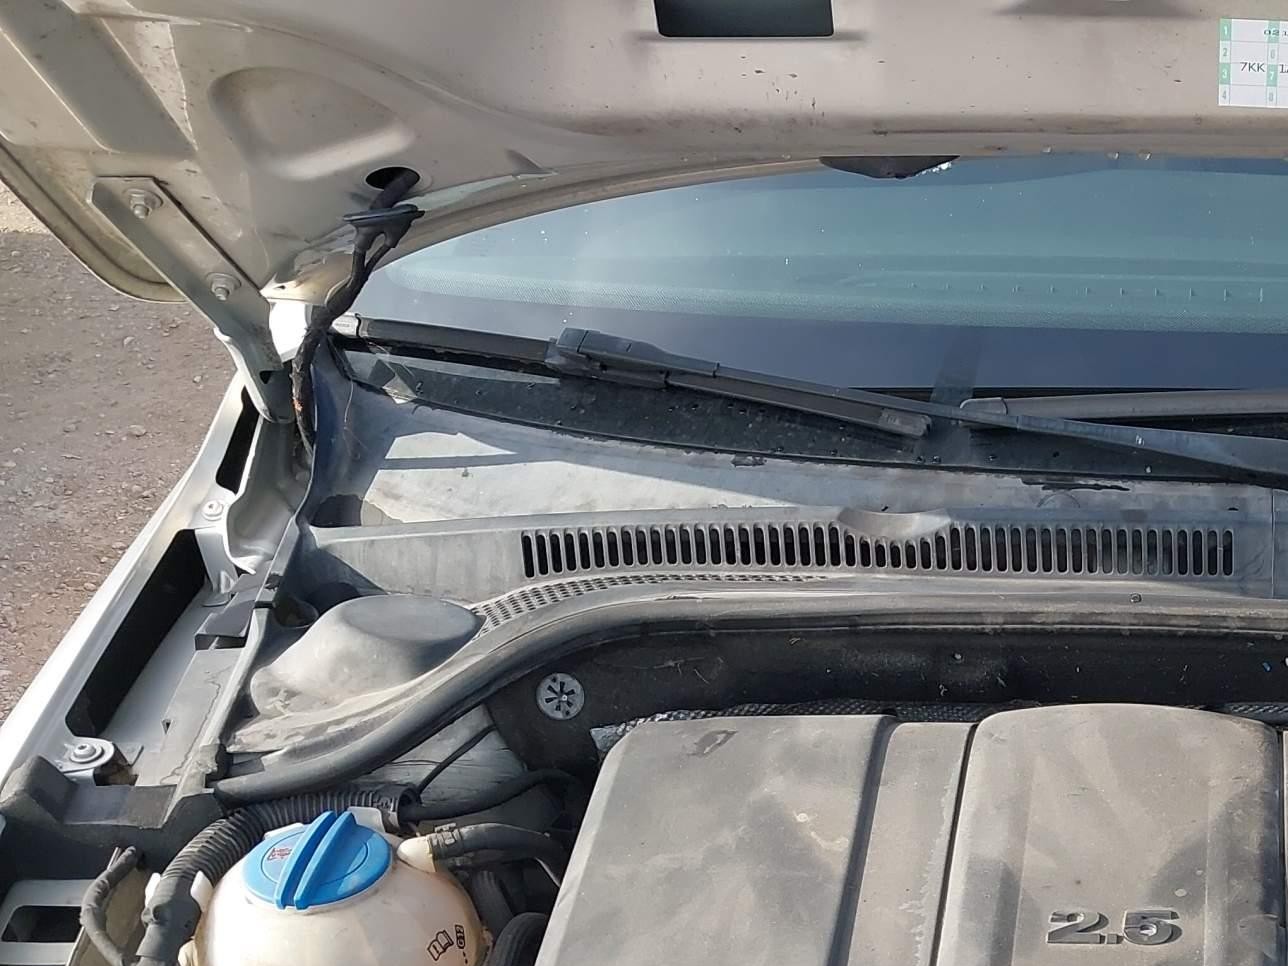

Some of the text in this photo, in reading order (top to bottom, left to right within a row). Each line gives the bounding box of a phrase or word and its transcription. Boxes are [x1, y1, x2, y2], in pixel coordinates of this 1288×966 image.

[1223, 25, 1229, 36] 1
[1223, 47, 1228, 57] 2
[1240, 61, 1266, 73] 7KK
[1269, 71, 1275, 81] 7
[1222, 90, 1227, 100] 4
[1046, 908, 1183, 946] 2.5
